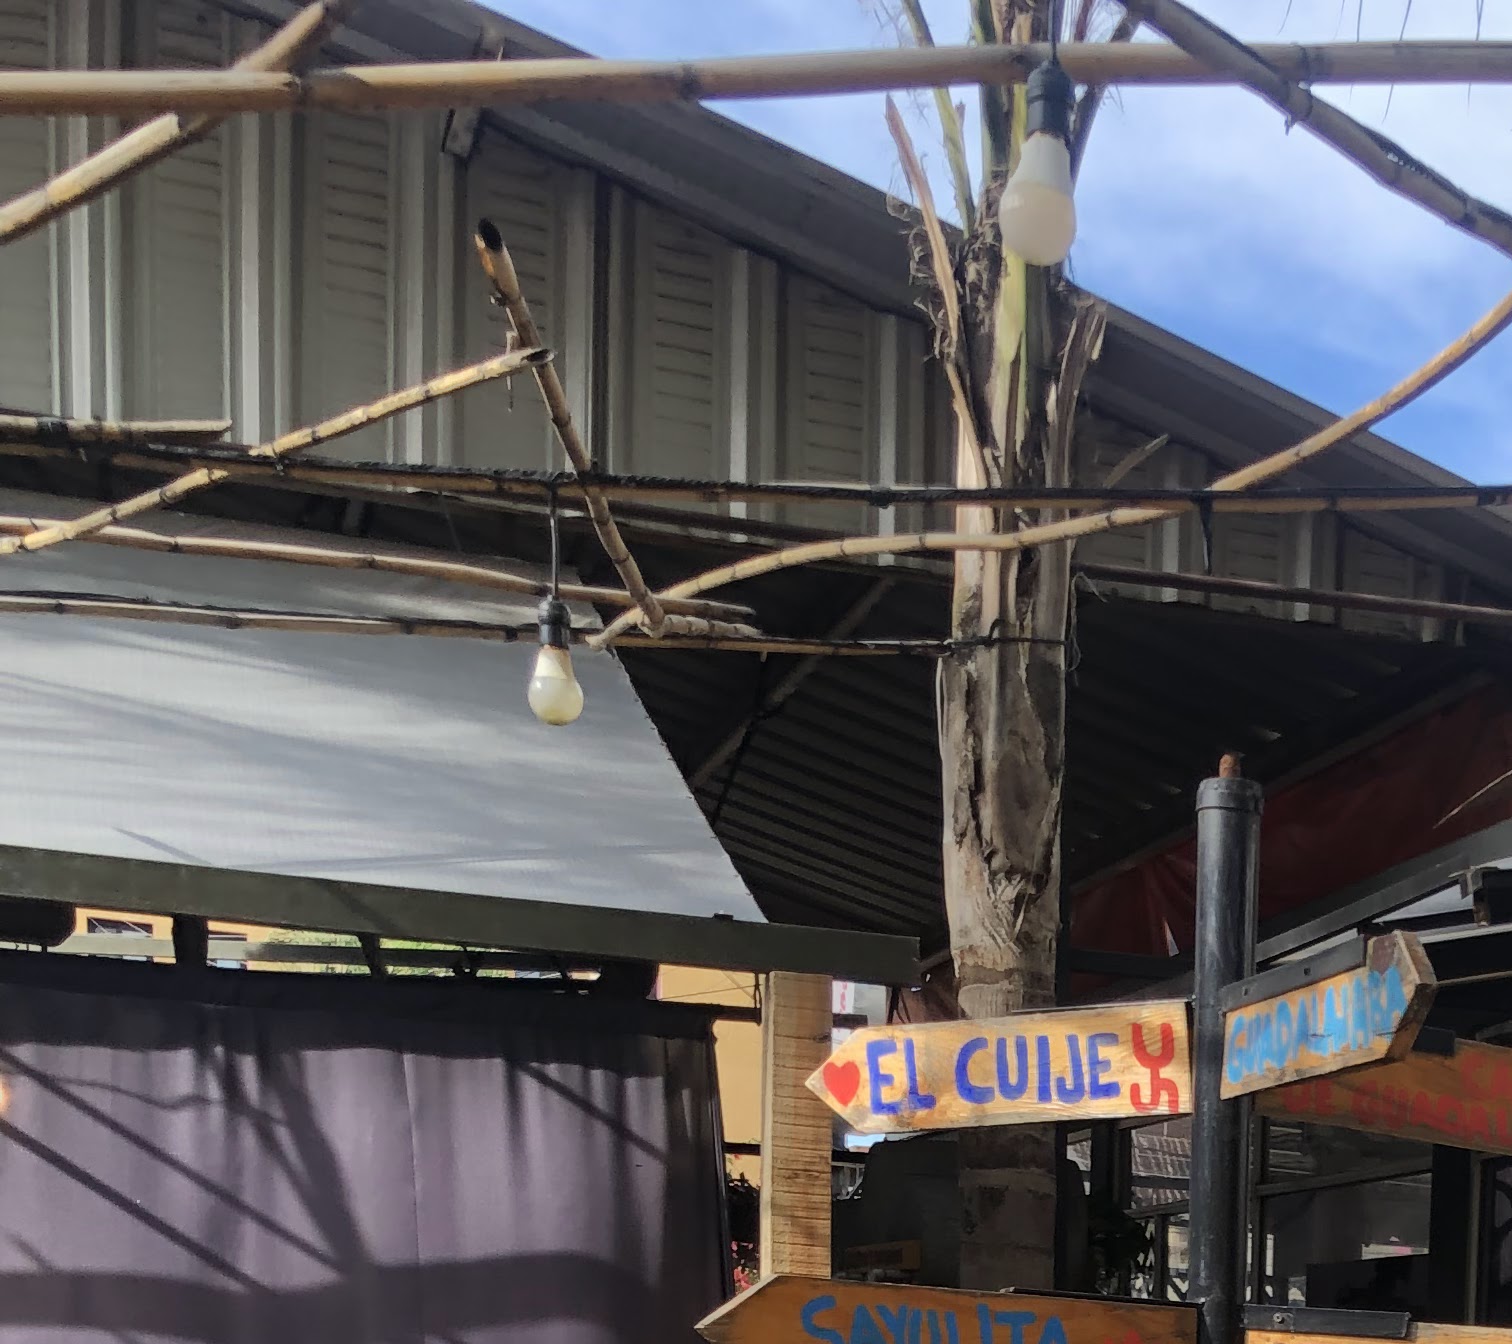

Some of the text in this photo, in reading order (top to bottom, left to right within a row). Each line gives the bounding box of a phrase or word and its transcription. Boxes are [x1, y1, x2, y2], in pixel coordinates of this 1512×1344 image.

[866, 1032, 1122, 1117] EL CUIJE
[1282, 1079, 1335, 1117] DE
